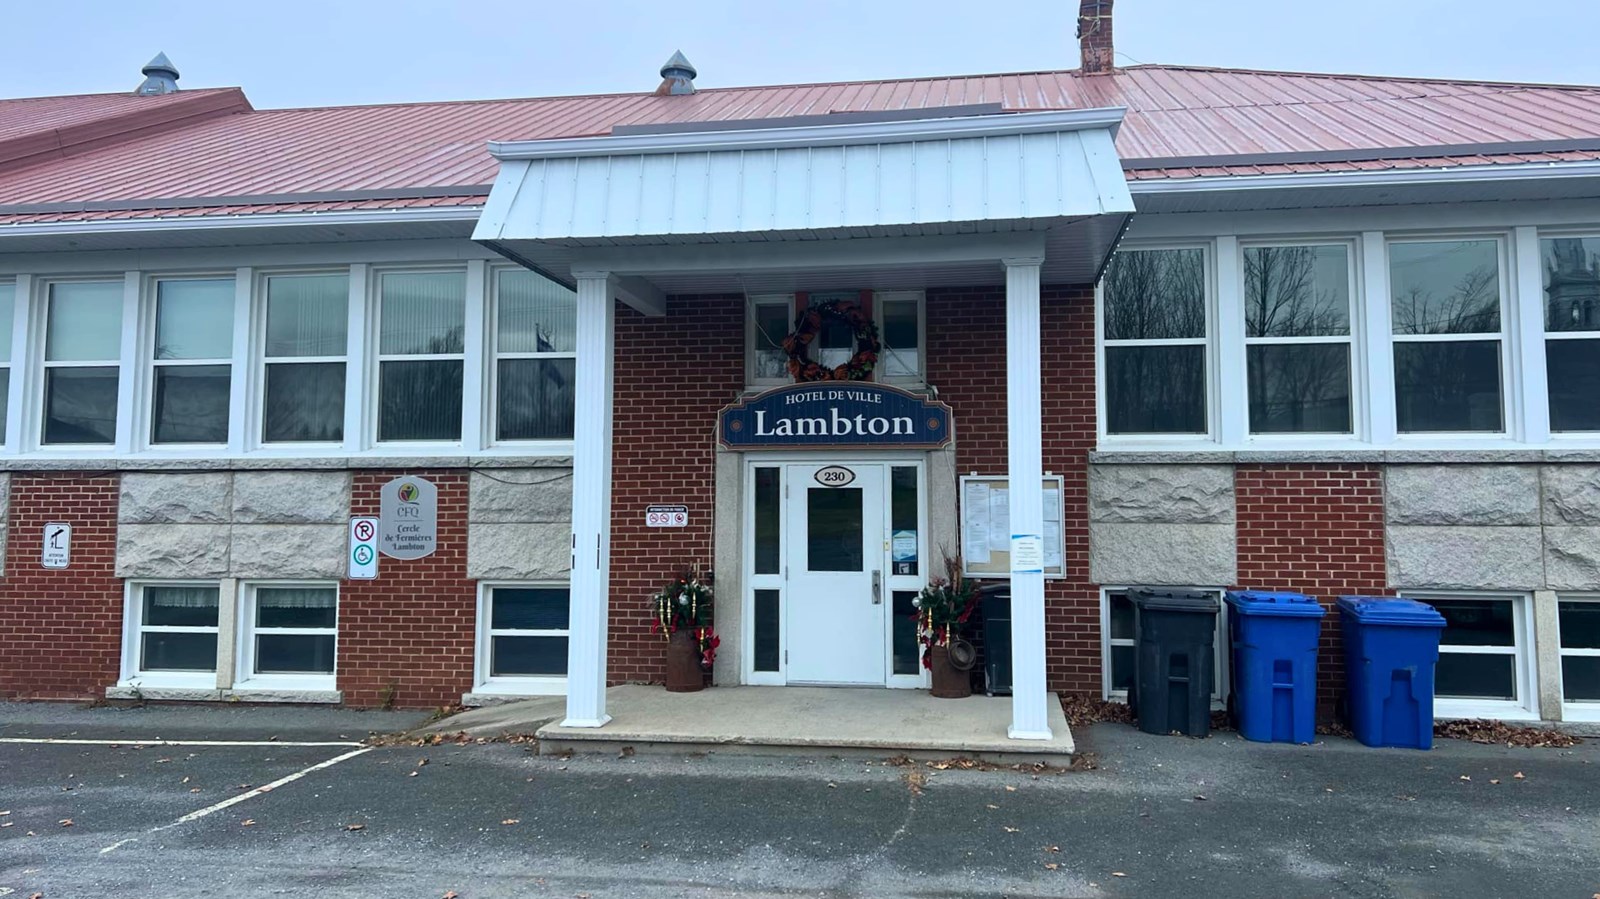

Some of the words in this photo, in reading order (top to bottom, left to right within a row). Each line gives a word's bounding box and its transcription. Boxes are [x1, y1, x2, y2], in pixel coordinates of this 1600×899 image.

[785, 391, 826, 405] HOTEL
[828, 391, 844, 400] DE
[846, 391, 882, 404] VILLE
[754, 408, 915, 436] Lambton
[824, 472, 845, 482] 230
[397, 506, 419, 518] CFQ
[397, 524, 420, 533] Cercle
